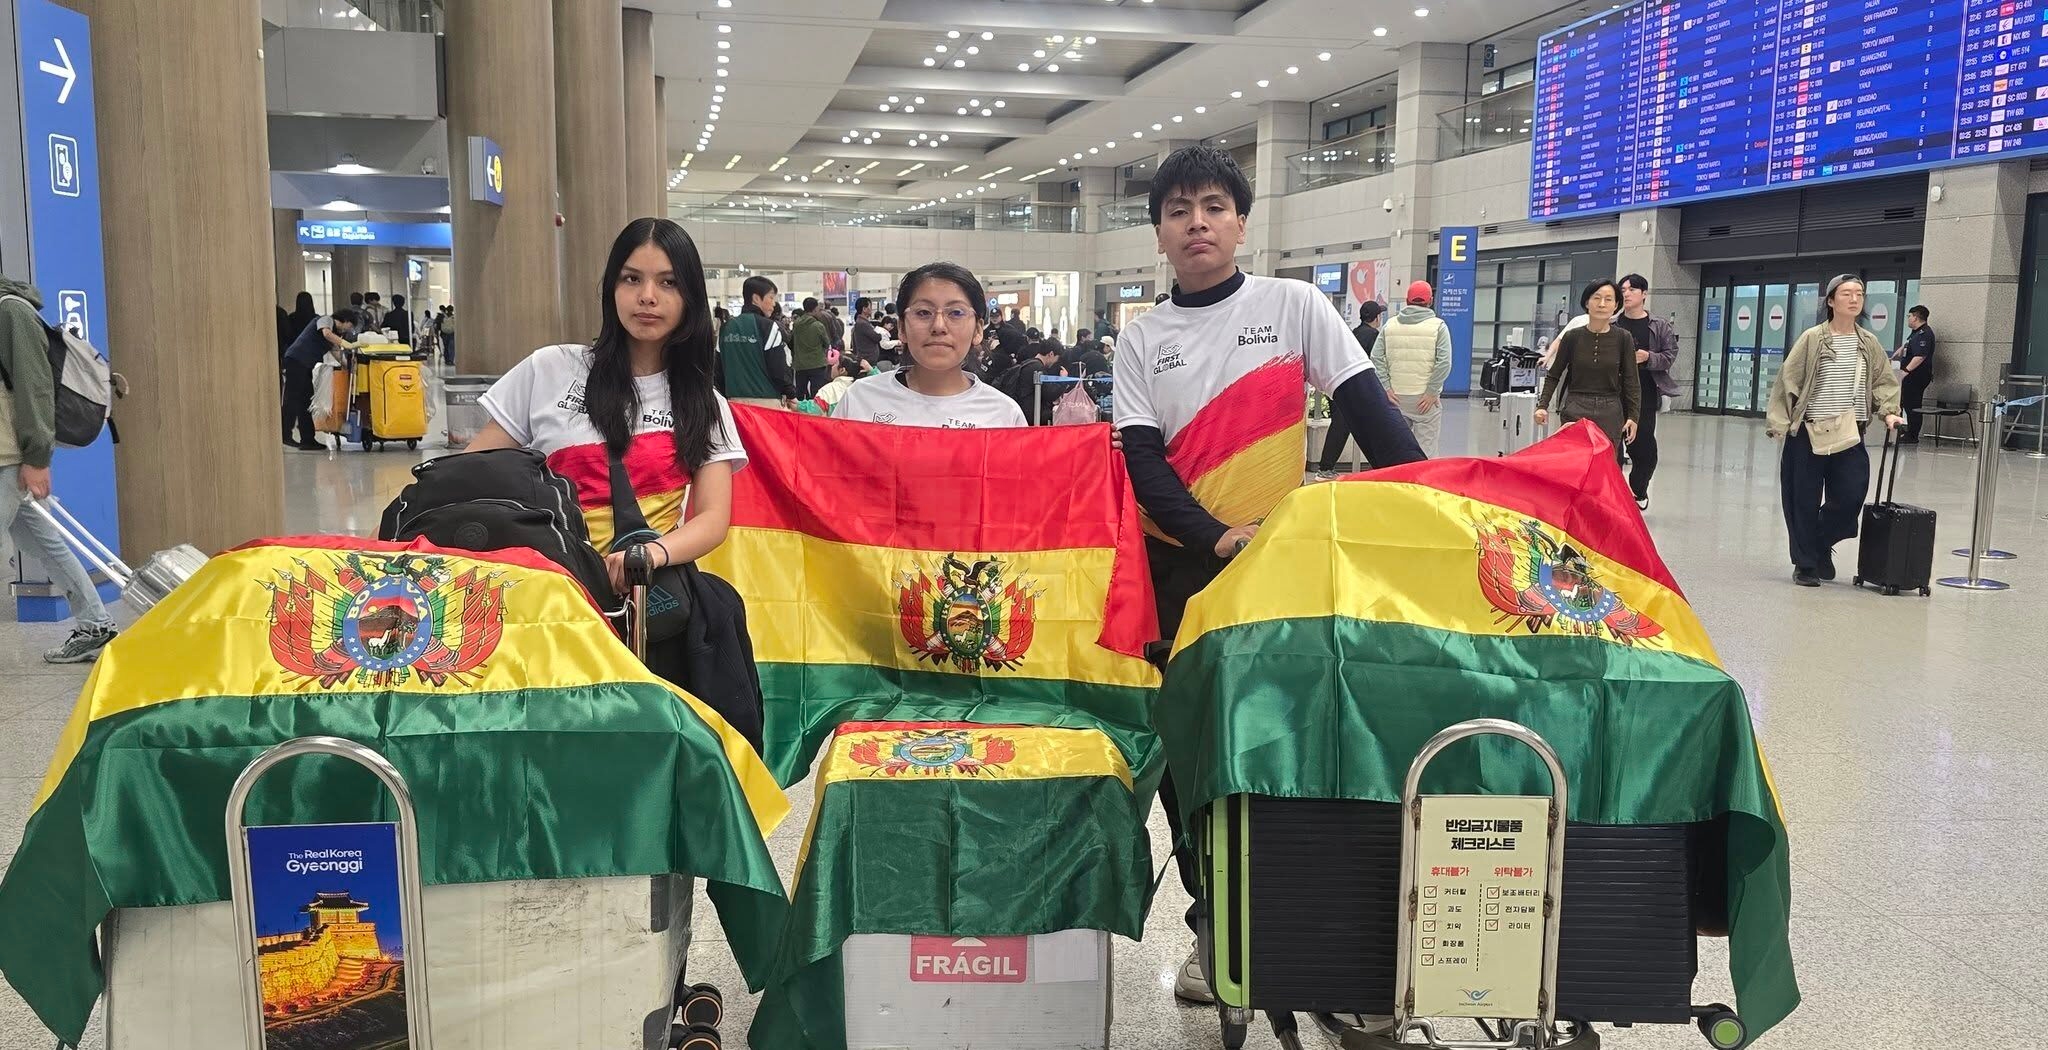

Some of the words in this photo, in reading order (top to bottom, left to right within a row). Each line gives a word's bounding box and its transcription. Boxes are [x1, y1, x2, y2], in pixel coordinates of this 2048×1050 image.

[2012, 47, 2021, 56] WE
[2010, 63, 2018, 71] ET
[2008, 94, 2016, 102] SC
[1451, 235, 1467, 262] E
[1243, 326, 1272, 336] TEAM
[1238, 333, 1278, 346] Bolivia
[1157, 353, 1180, 366] FIRST
[1153, 360, 1188, 375] GLOBAL
[643, 414, 675, 428] Boliv
[648, 600, 680, 616] didas
[1445, 819, 1523, 832] 반입금지물품
[1451, 837, 1516, 850] 체크리스트
[304, 849, 329, 858] Real
[330, 848, 362, 858] Korea
[286, 857, 363, 875] Gyeonggi
[1431, 866, 1470, 876] 휴대불가
[1494, 867, 1533, 877] 위탁불가
[1508, 922, 1530, 930] 라이터
[916, 952, 1018, 976] FRÁGIL
[1438, 957, 1468, 965] 스프레이
